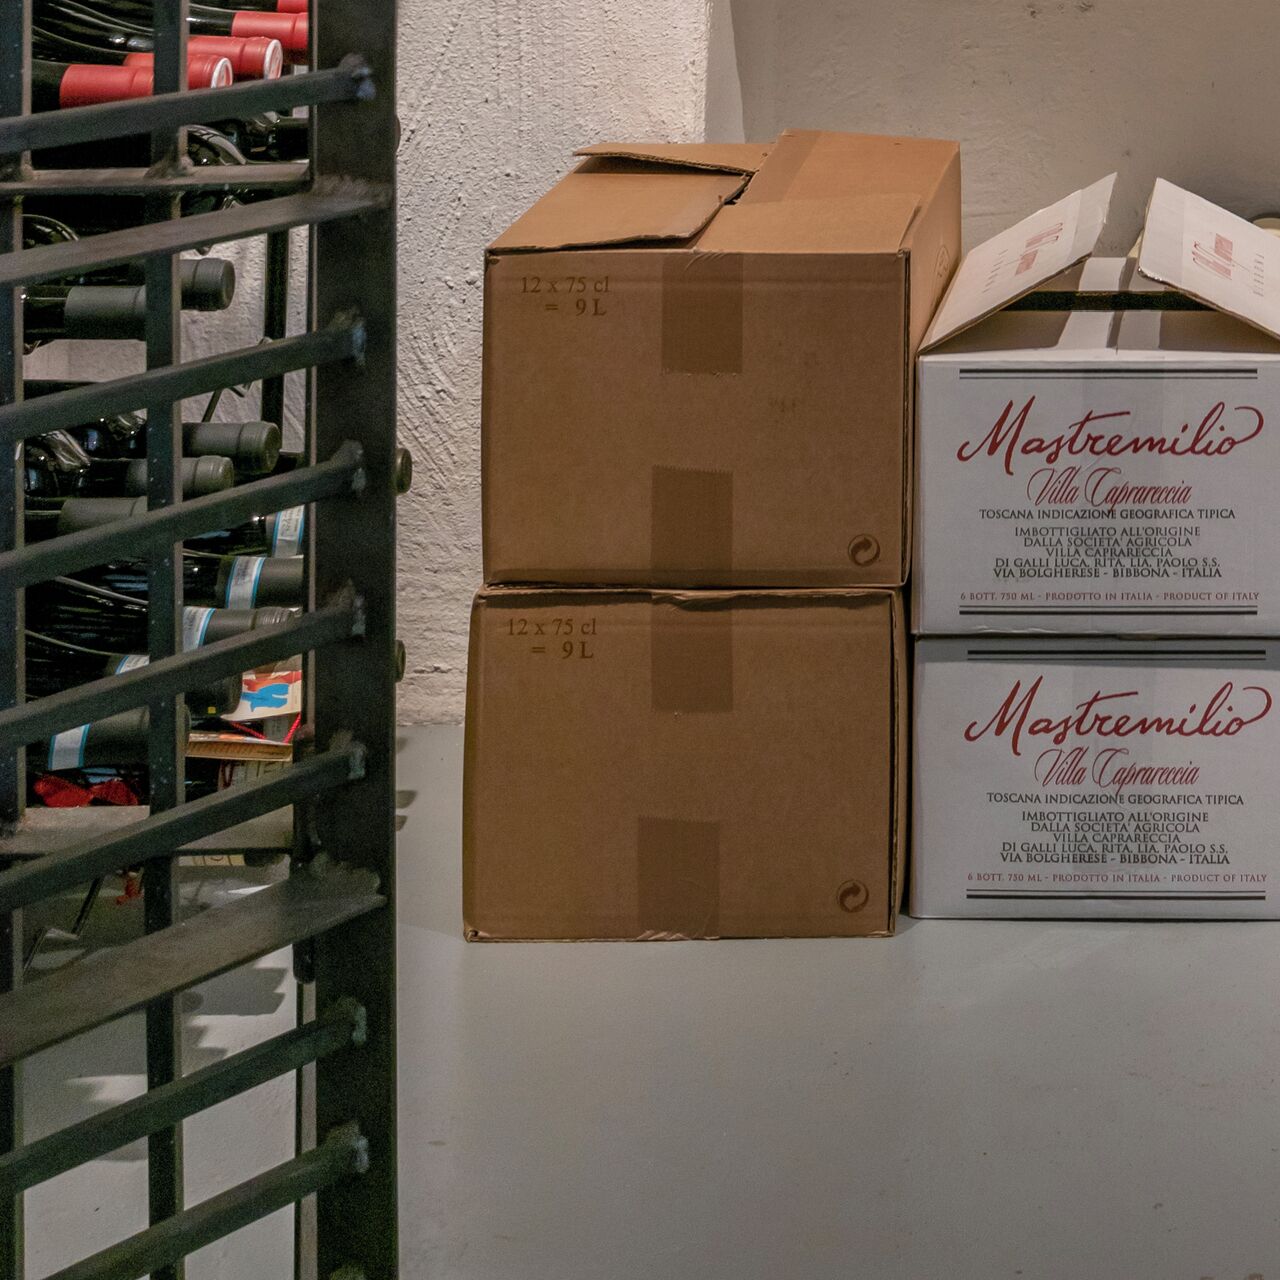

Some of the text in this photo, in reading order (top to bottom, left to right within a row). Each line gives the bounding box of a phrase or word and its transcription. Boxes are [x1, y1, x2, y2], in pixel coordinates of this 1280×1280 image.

[521, 276, 541, 293] 12
[566, 276, 587, 293] 75
[575, 298, 587, 316] 9
[592, 298, 607, 316] L
[957, 395, 1264, 475] Mastremilio
[1027, 466, 1193, 512] Villa Caprareccia
[979, 509, 1235, 520] TOSCANA INDICAZIONE GEOGRAFICA TIPICA
[1014, 527, 1201, 537] IMBOTTIGLIATO ALL'ORIGINE
[1024, 537, 1064, 547] DALLA
[1127, 537, 1192, 547] AGRICOLA
[1046, 548, 1173, 558] VILLA CAPRARECCIA
[995, 558, 1011, 568] DI
[1014, 558, 1050, 568] GALLI
[1156, 558, 1199, 568] PAOLO
[993, 568, 1015, 578] VIA
[1019, 568, 1100, 578] BOLGHERESE
[1112, 568, 1169, 578] BIBBONA
[1181, 568, 1222, 578] ITALIA
[1020, 592, 1036, 602] ML
[1045, 592, 1101, 602] PRODOTTO
[1105, 592, 1117, 602] IN
[1121, 592, 1153, 602] ITALIA
[1163, 592, 1213, 602] PRODUCT
[1216, 592, 1228, 602] OF
[1231, 592, 1260, 602] ITALY
[508, 618, 528, 636] 12
[534, 623, 545, 635] x
[551, 618, 574, 635] 75
[562, 640, 574, 659] 9
[580, 640, 594, 659] L
[964, 675, 1272, 756] Mastremilio
[1034, 747, 1200, 795] Villa Caprareccia
[987, 793, 1244, 805] TOSCANA INDICAZIONE GEOGRAFICA TIPICA
[1022, 812, 1209, 822] IMBOTTIGLIATO ALL'ORIGINE
[1031, 823, 1071, 833] DALLA
[1134, 823, 1200, 833] AGRICOLA
[1053, 834, 1180, 843] VILLA CAPRARECCIA
[1002, 842, 1016, 853] DI
[1020, 842, 1056, 853] GALLI
[1164, 842, 1206, 853] PAOLO
[1000, 853, 1022, 864] VIA
[1026, 853, 1107, 864] BOLGHERESE
[1120, 853, 1176, 864] BIBBONA
[1189, 853, 1230, 864] ITALIA
[1028, 873, 1042, 882] ML
[1052, 873, 1108, 882] PRODOTTO
[1112, 873, 1125, 882] IN
[1128, 873, 1160, 882] ITALIA
[1171, 873, 1220, 882] PRODUCT
[1223, 873, 1236, 882] OF
[1240, 873, 1267, 882] ITALY
